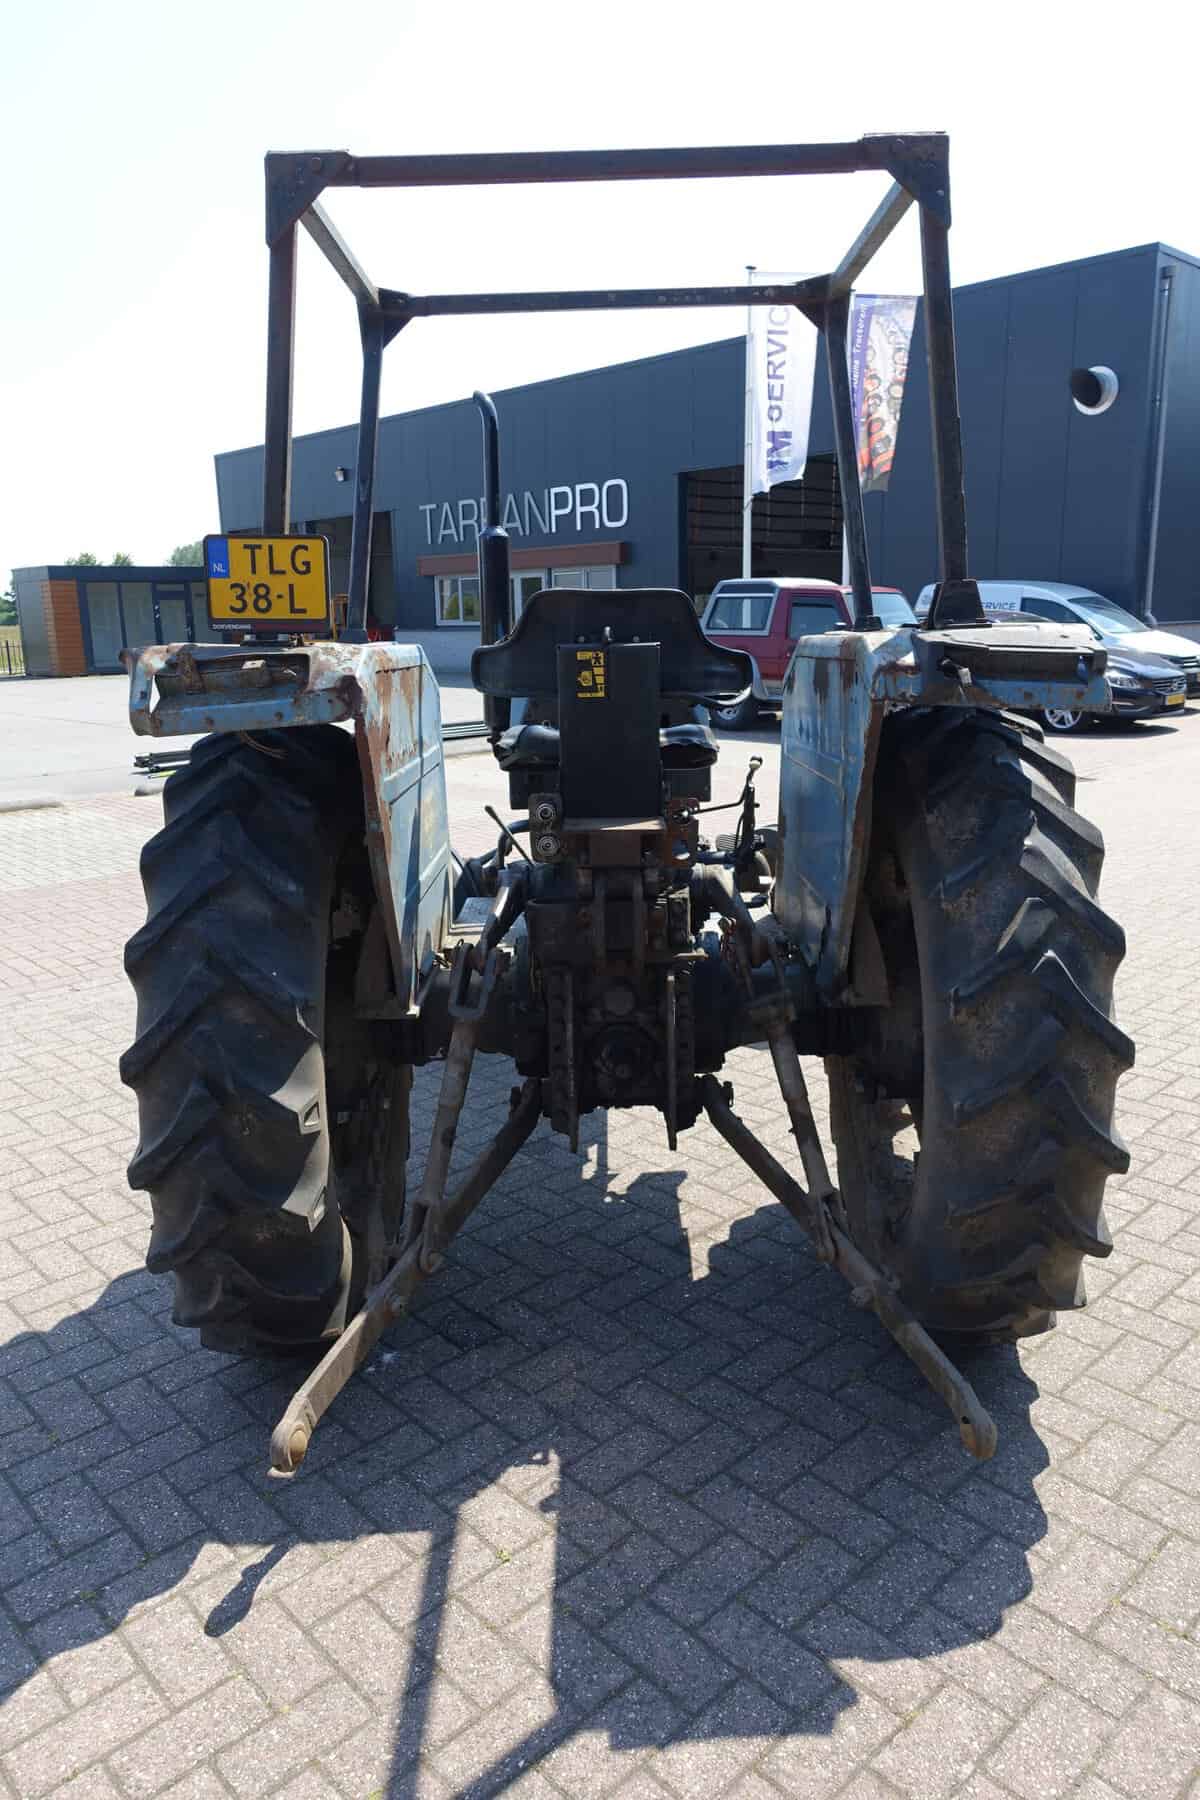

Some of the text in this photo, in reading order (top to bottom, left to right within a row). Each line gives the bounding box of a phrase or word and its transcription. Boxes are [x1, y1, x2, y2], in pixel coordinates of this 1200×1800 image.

[419, 478, 628, 544] TARANPRO
[213, 562, 226, 573] NL
[243, 544, 311, 575] TLG
[229, 582, 307, 614] 38-L
